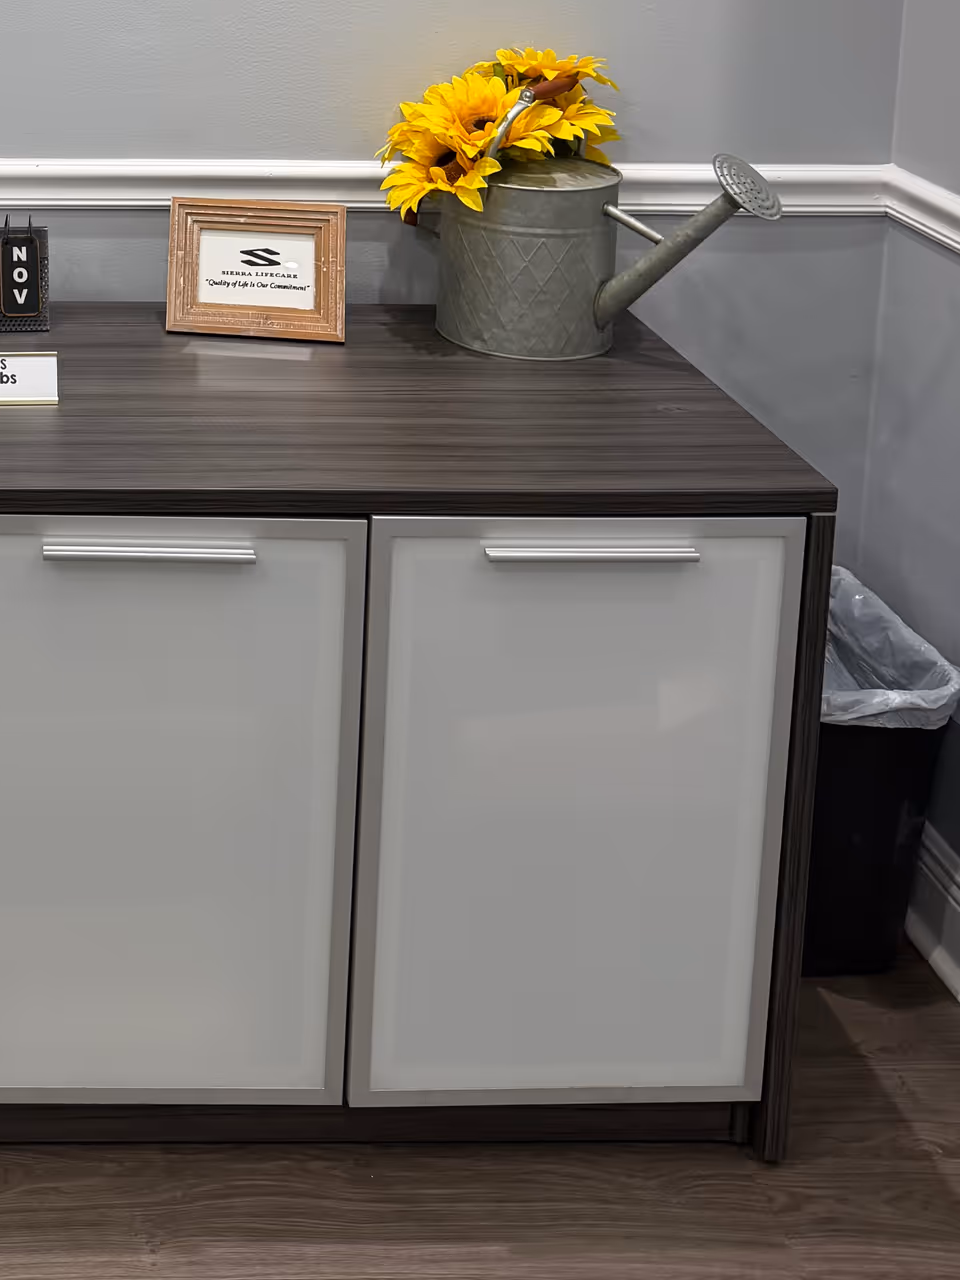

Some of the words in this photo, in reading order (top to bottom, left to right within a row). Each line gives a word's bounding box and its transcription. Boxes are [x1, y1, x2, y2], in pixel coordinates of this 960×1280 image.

[12, 246, 28, 304] NOV
[255, 271, 298, 279] LIFECARE
[231, 280, 237, 288] of
[238, 280, 248, 288] Life
